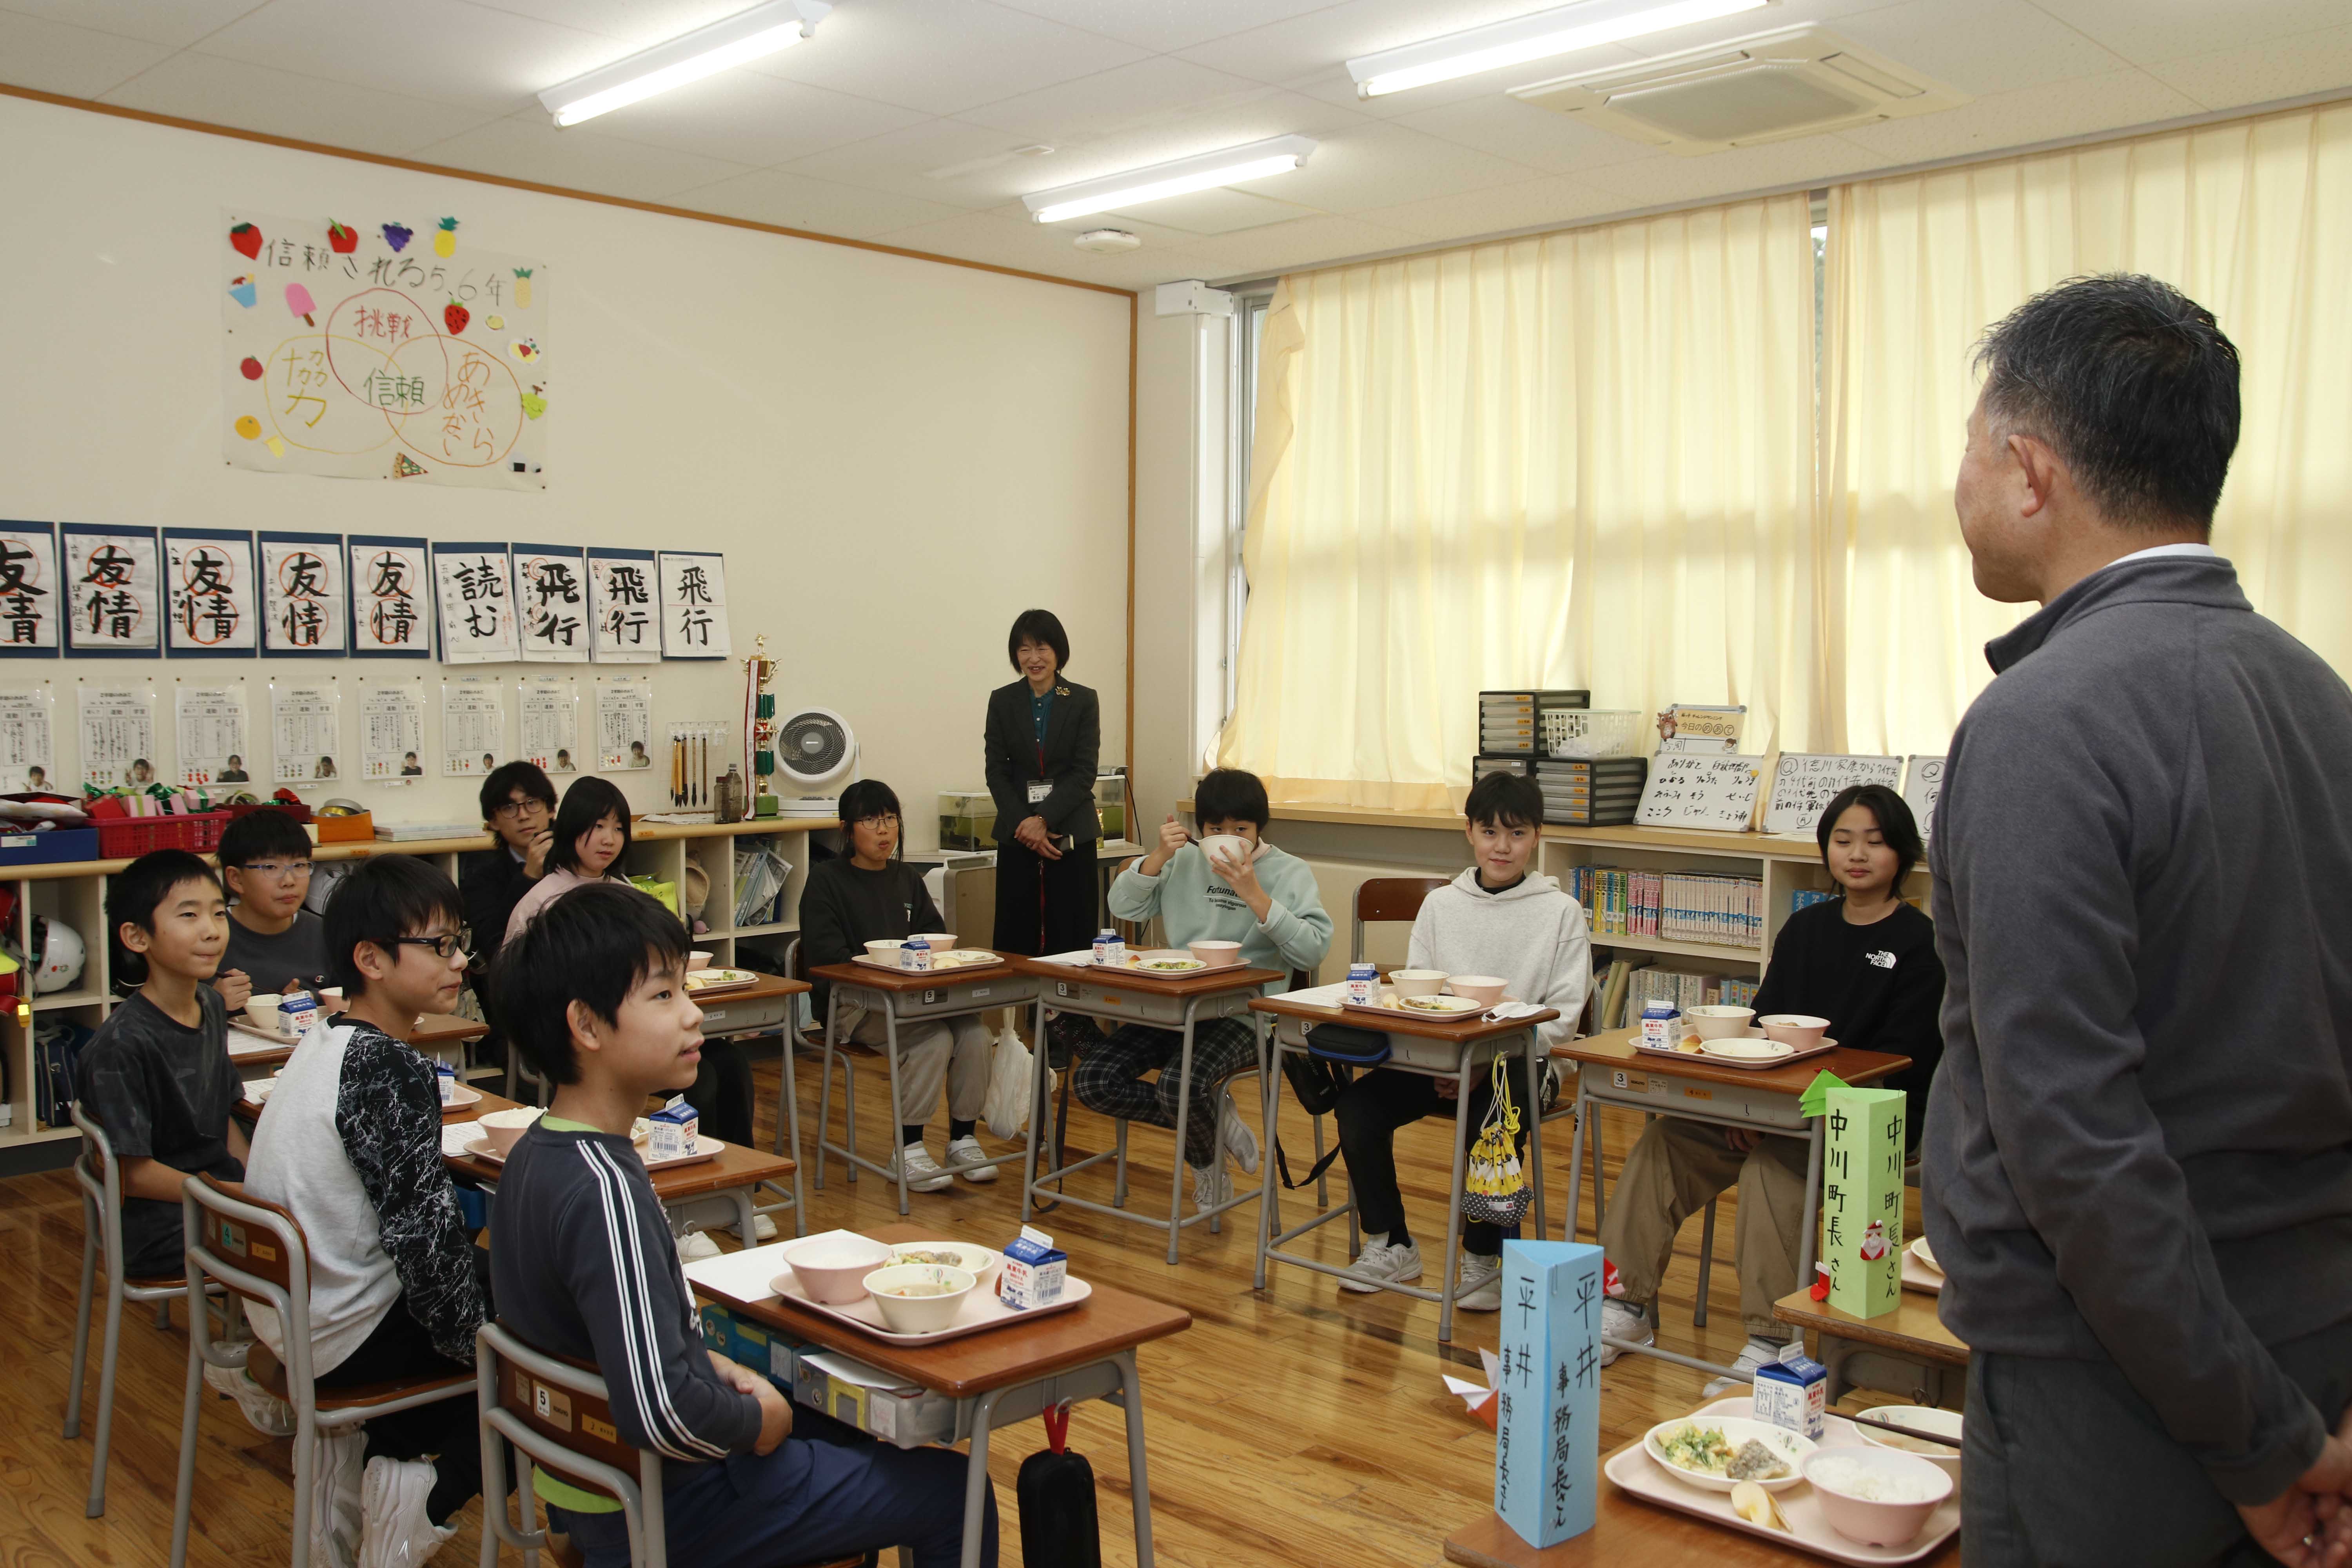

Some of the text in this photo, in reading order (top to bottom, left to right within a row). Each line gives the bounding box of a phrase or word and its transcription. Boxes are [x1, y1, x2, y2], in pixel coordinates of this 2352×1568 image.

[353, 305, 413, 343] 挑戦
[282, 348, 328, 428] 協力
[363, 368, 425, 407] 信頼
[80, 544, 140, 639] 友情
[178, 549, 240, 639] 友情
[282, 552, 330, 645] 友情
[372, 551, 418, 643] 友情
[452, 555, 503, 638] 読む
[535, 563, 581, 646] 飛行
[608, 567, 649, 645] 飛行
[677, 566, 713, 646] 飛行
[1681, 722, 1734, 736] 今日のめあて
[1775, 799, 1830, 811] 前の将軍は
[1865, 953, 1887, 962] NORTH
[1617, 1073, 1623, 1082] 3
[1827, 1109, 1847, 1292] 中川町長さん
[1516, 1276, 1536, 1388] 平井
[1574, 1270, 1597, 1389] 平井
[540, 1391, 546, 1405] 5
[1499, 1344, 1513, 1512] 事務局長さん
[1552, 1361, 1572, 1528] 事務局長さん
